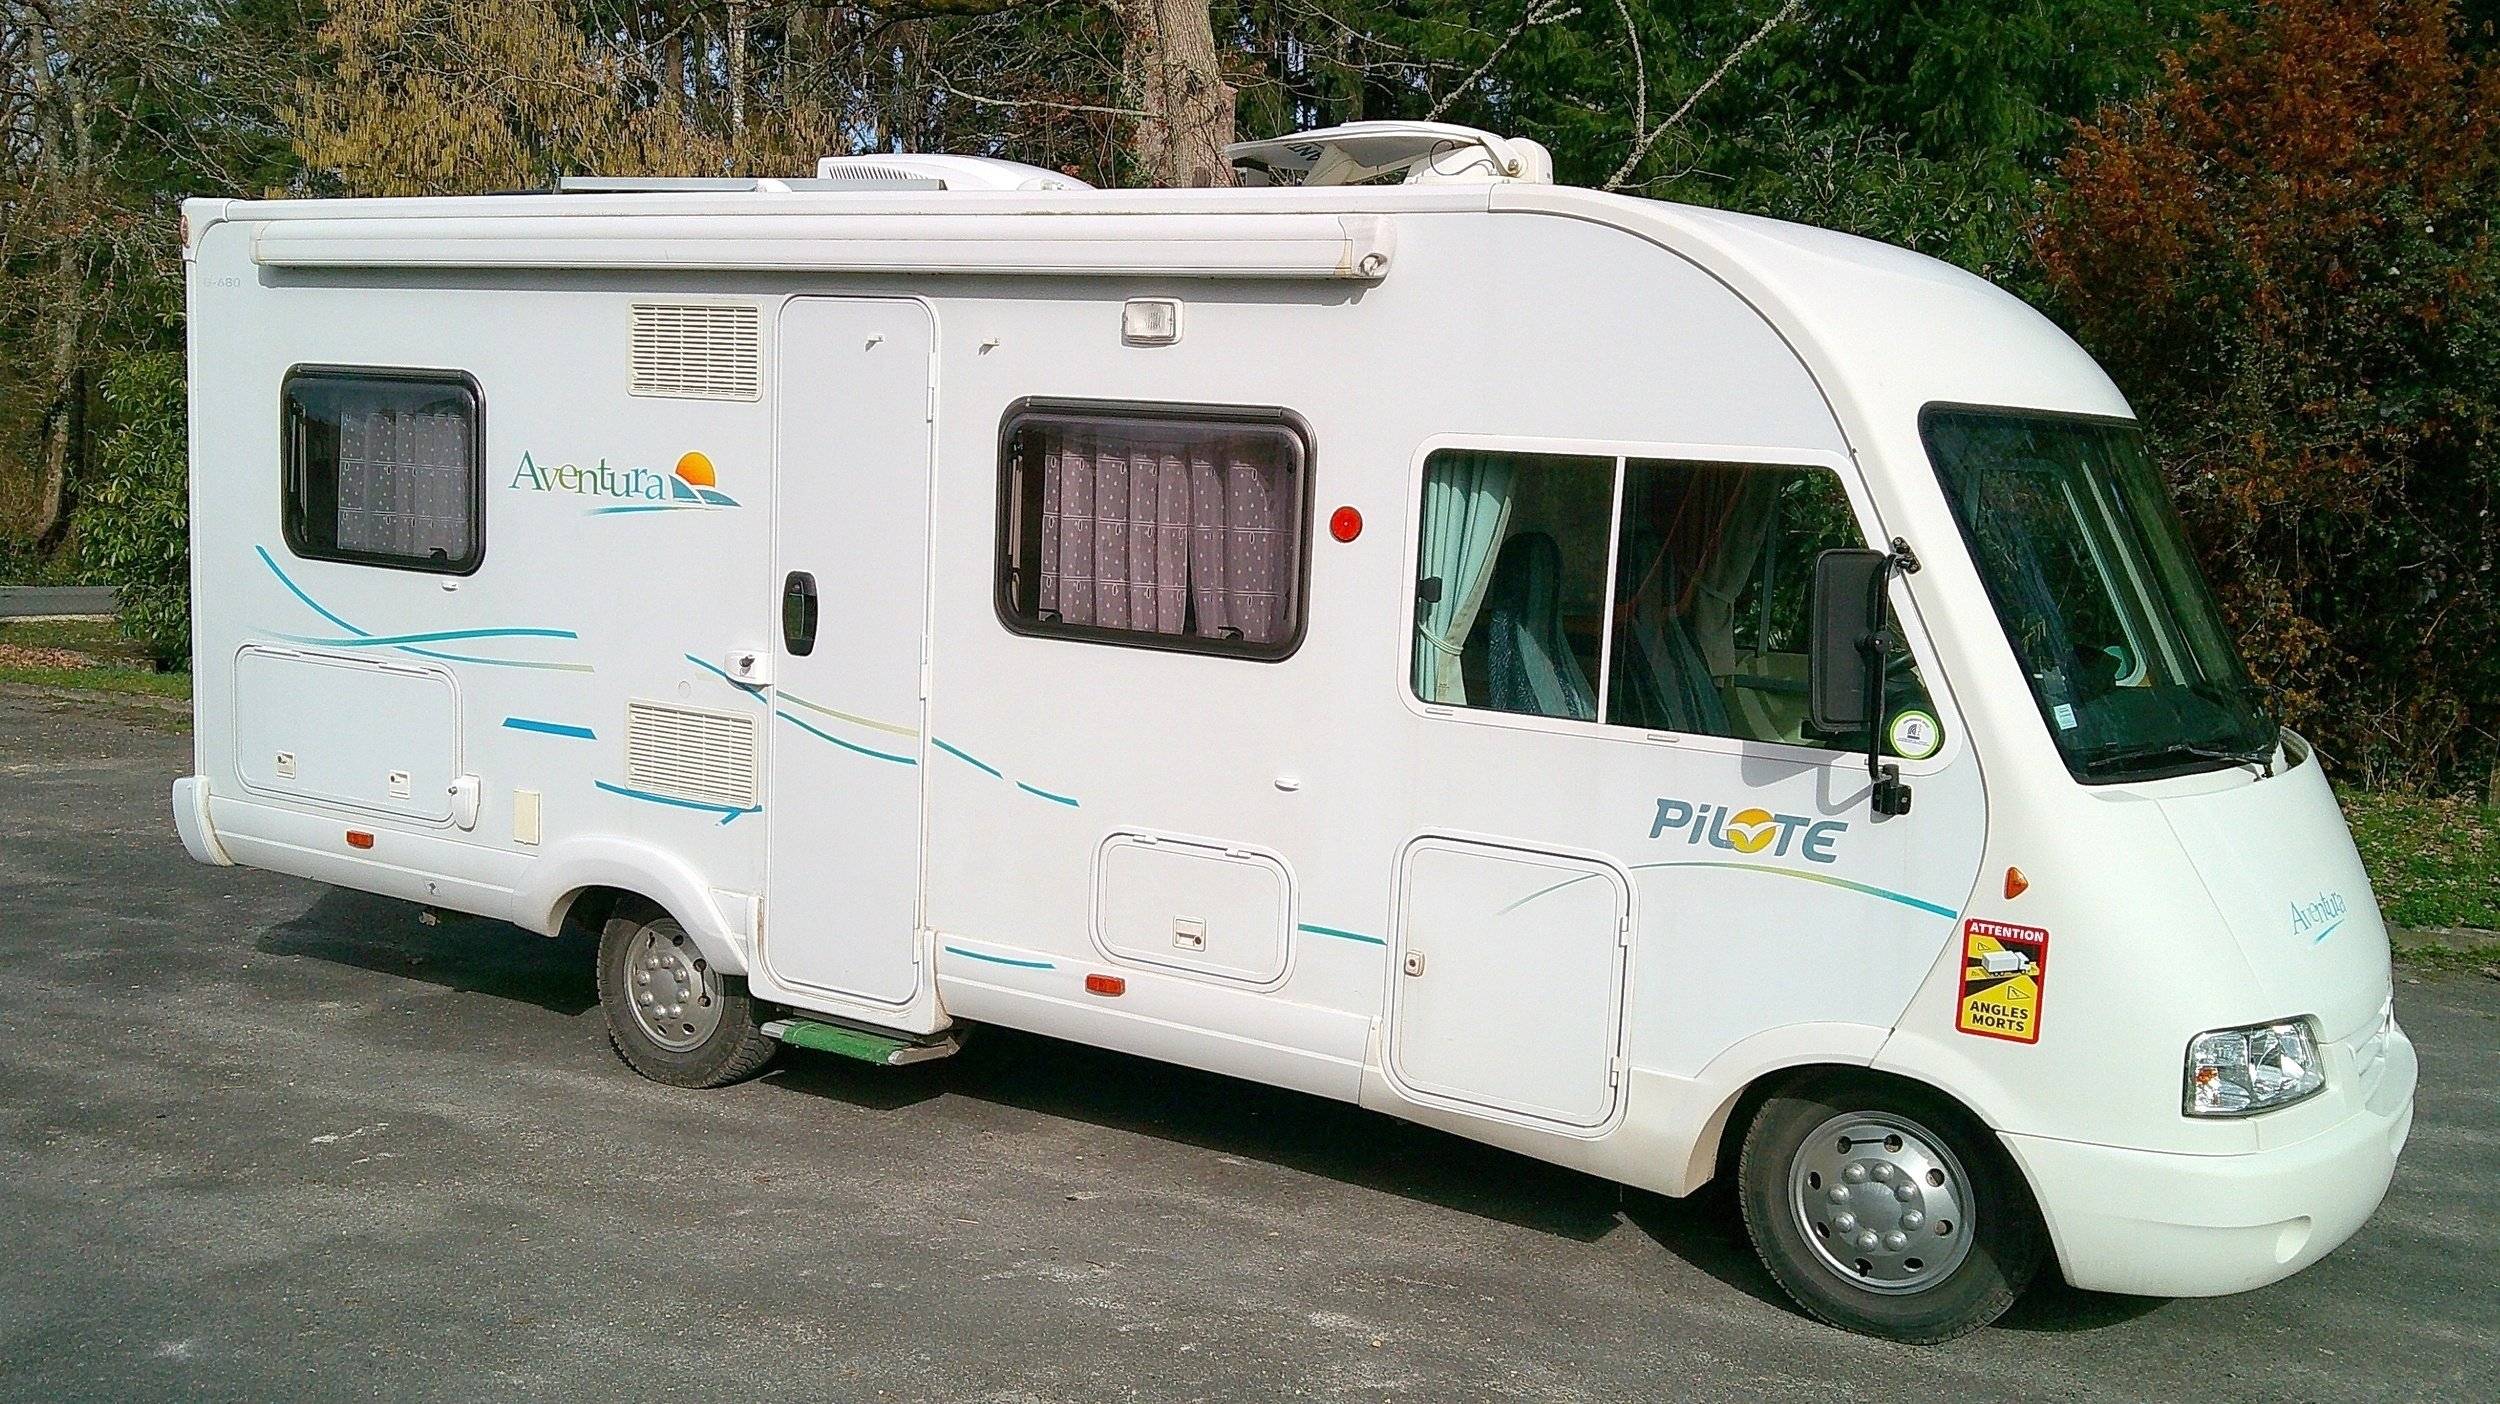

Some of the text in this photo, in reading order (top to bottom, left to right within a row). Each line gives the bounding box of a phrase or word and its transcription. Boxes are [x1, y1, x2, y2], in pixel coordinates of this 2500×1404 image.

[508, 449, 666, 500] Aventura
[1969, 922, 2044, 943] ATTENTION
[1970, 1001, 2029, 1020] ANGLES
[1972, 1014, 2025, 1032] MORTS
